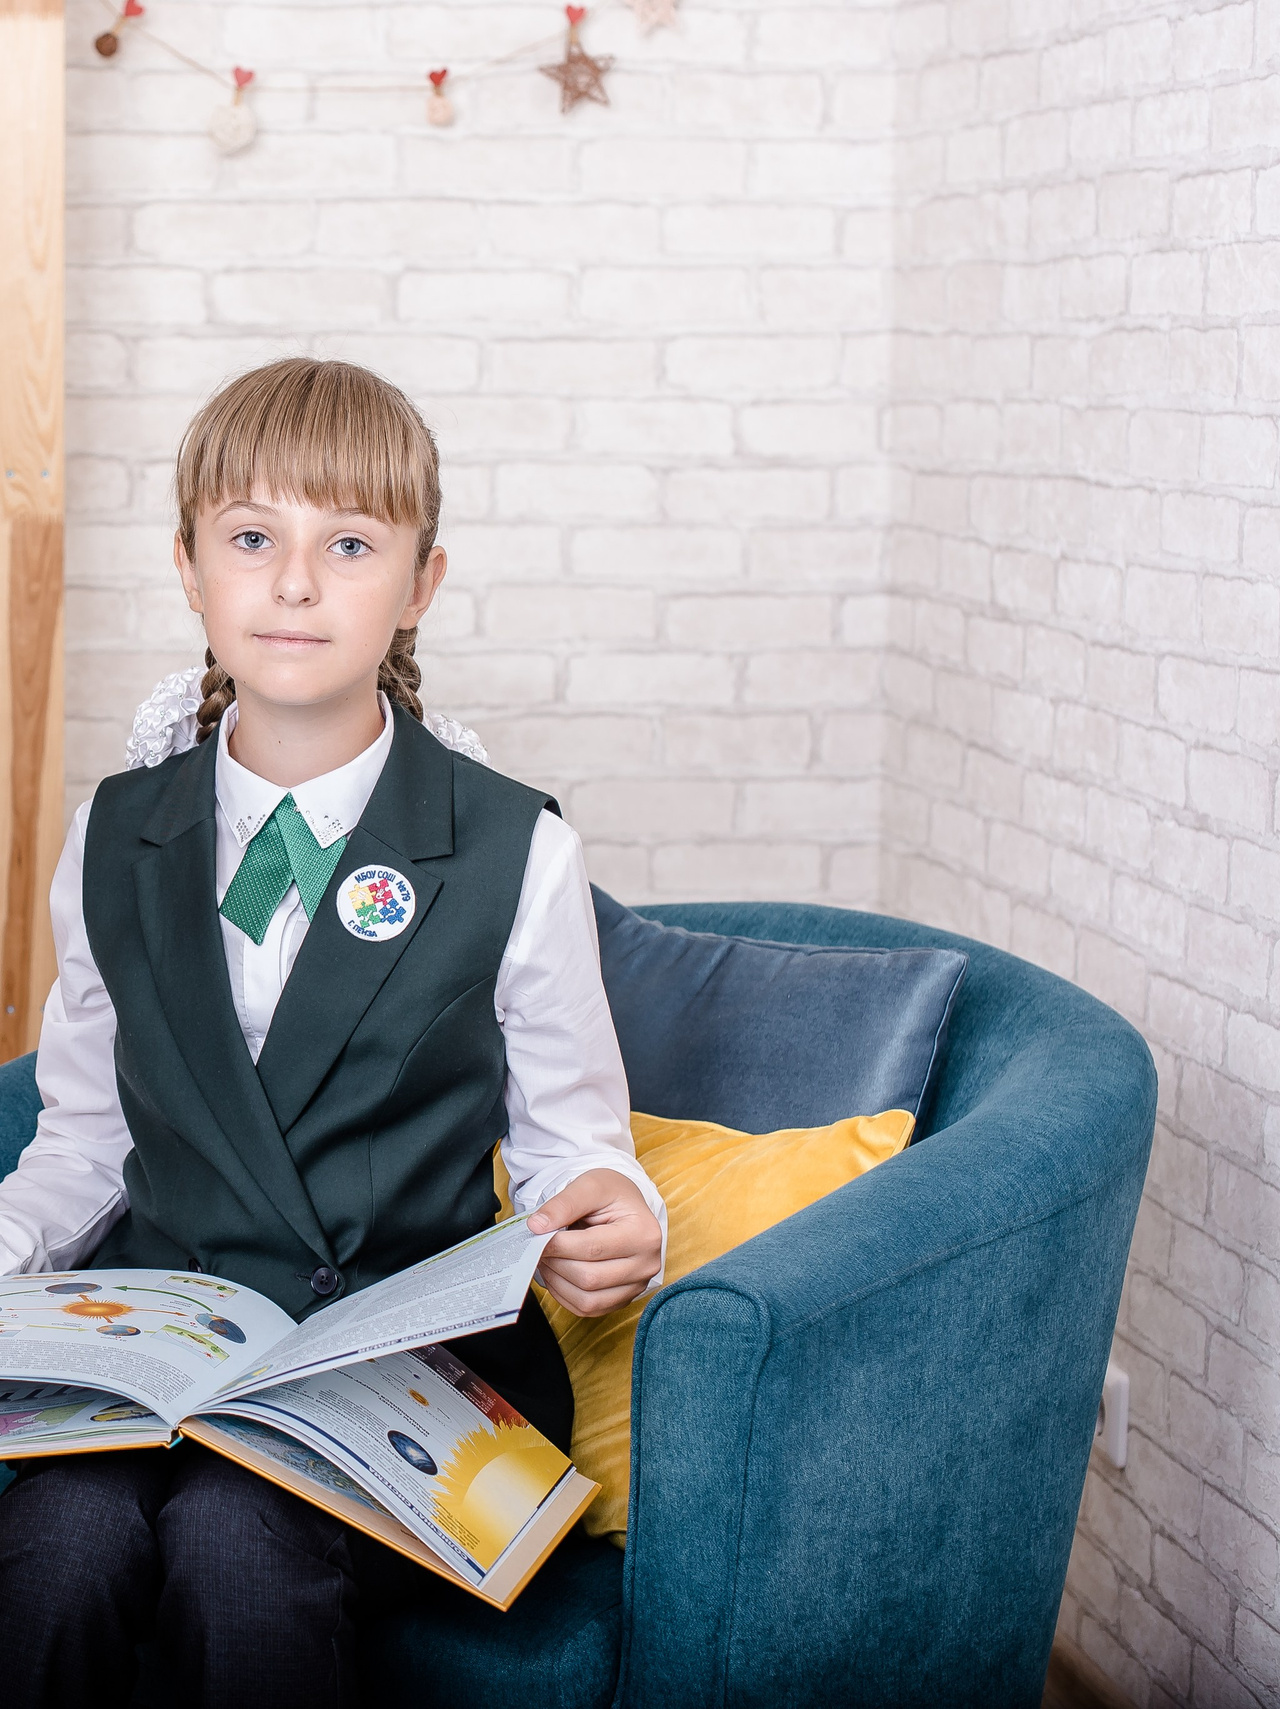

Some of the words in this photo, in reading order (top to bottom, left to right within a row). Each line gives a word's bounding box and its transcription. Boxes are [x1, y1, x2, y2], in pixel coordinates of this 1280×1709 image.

[354, 870, 377, 883] МБОУ
[377, 870, 397, 883] СОШ
[366, 1464, 413, 1507] СИСТЕМА
[410, 1505, 469, 1560] СОЛНЕЧНАЯ
